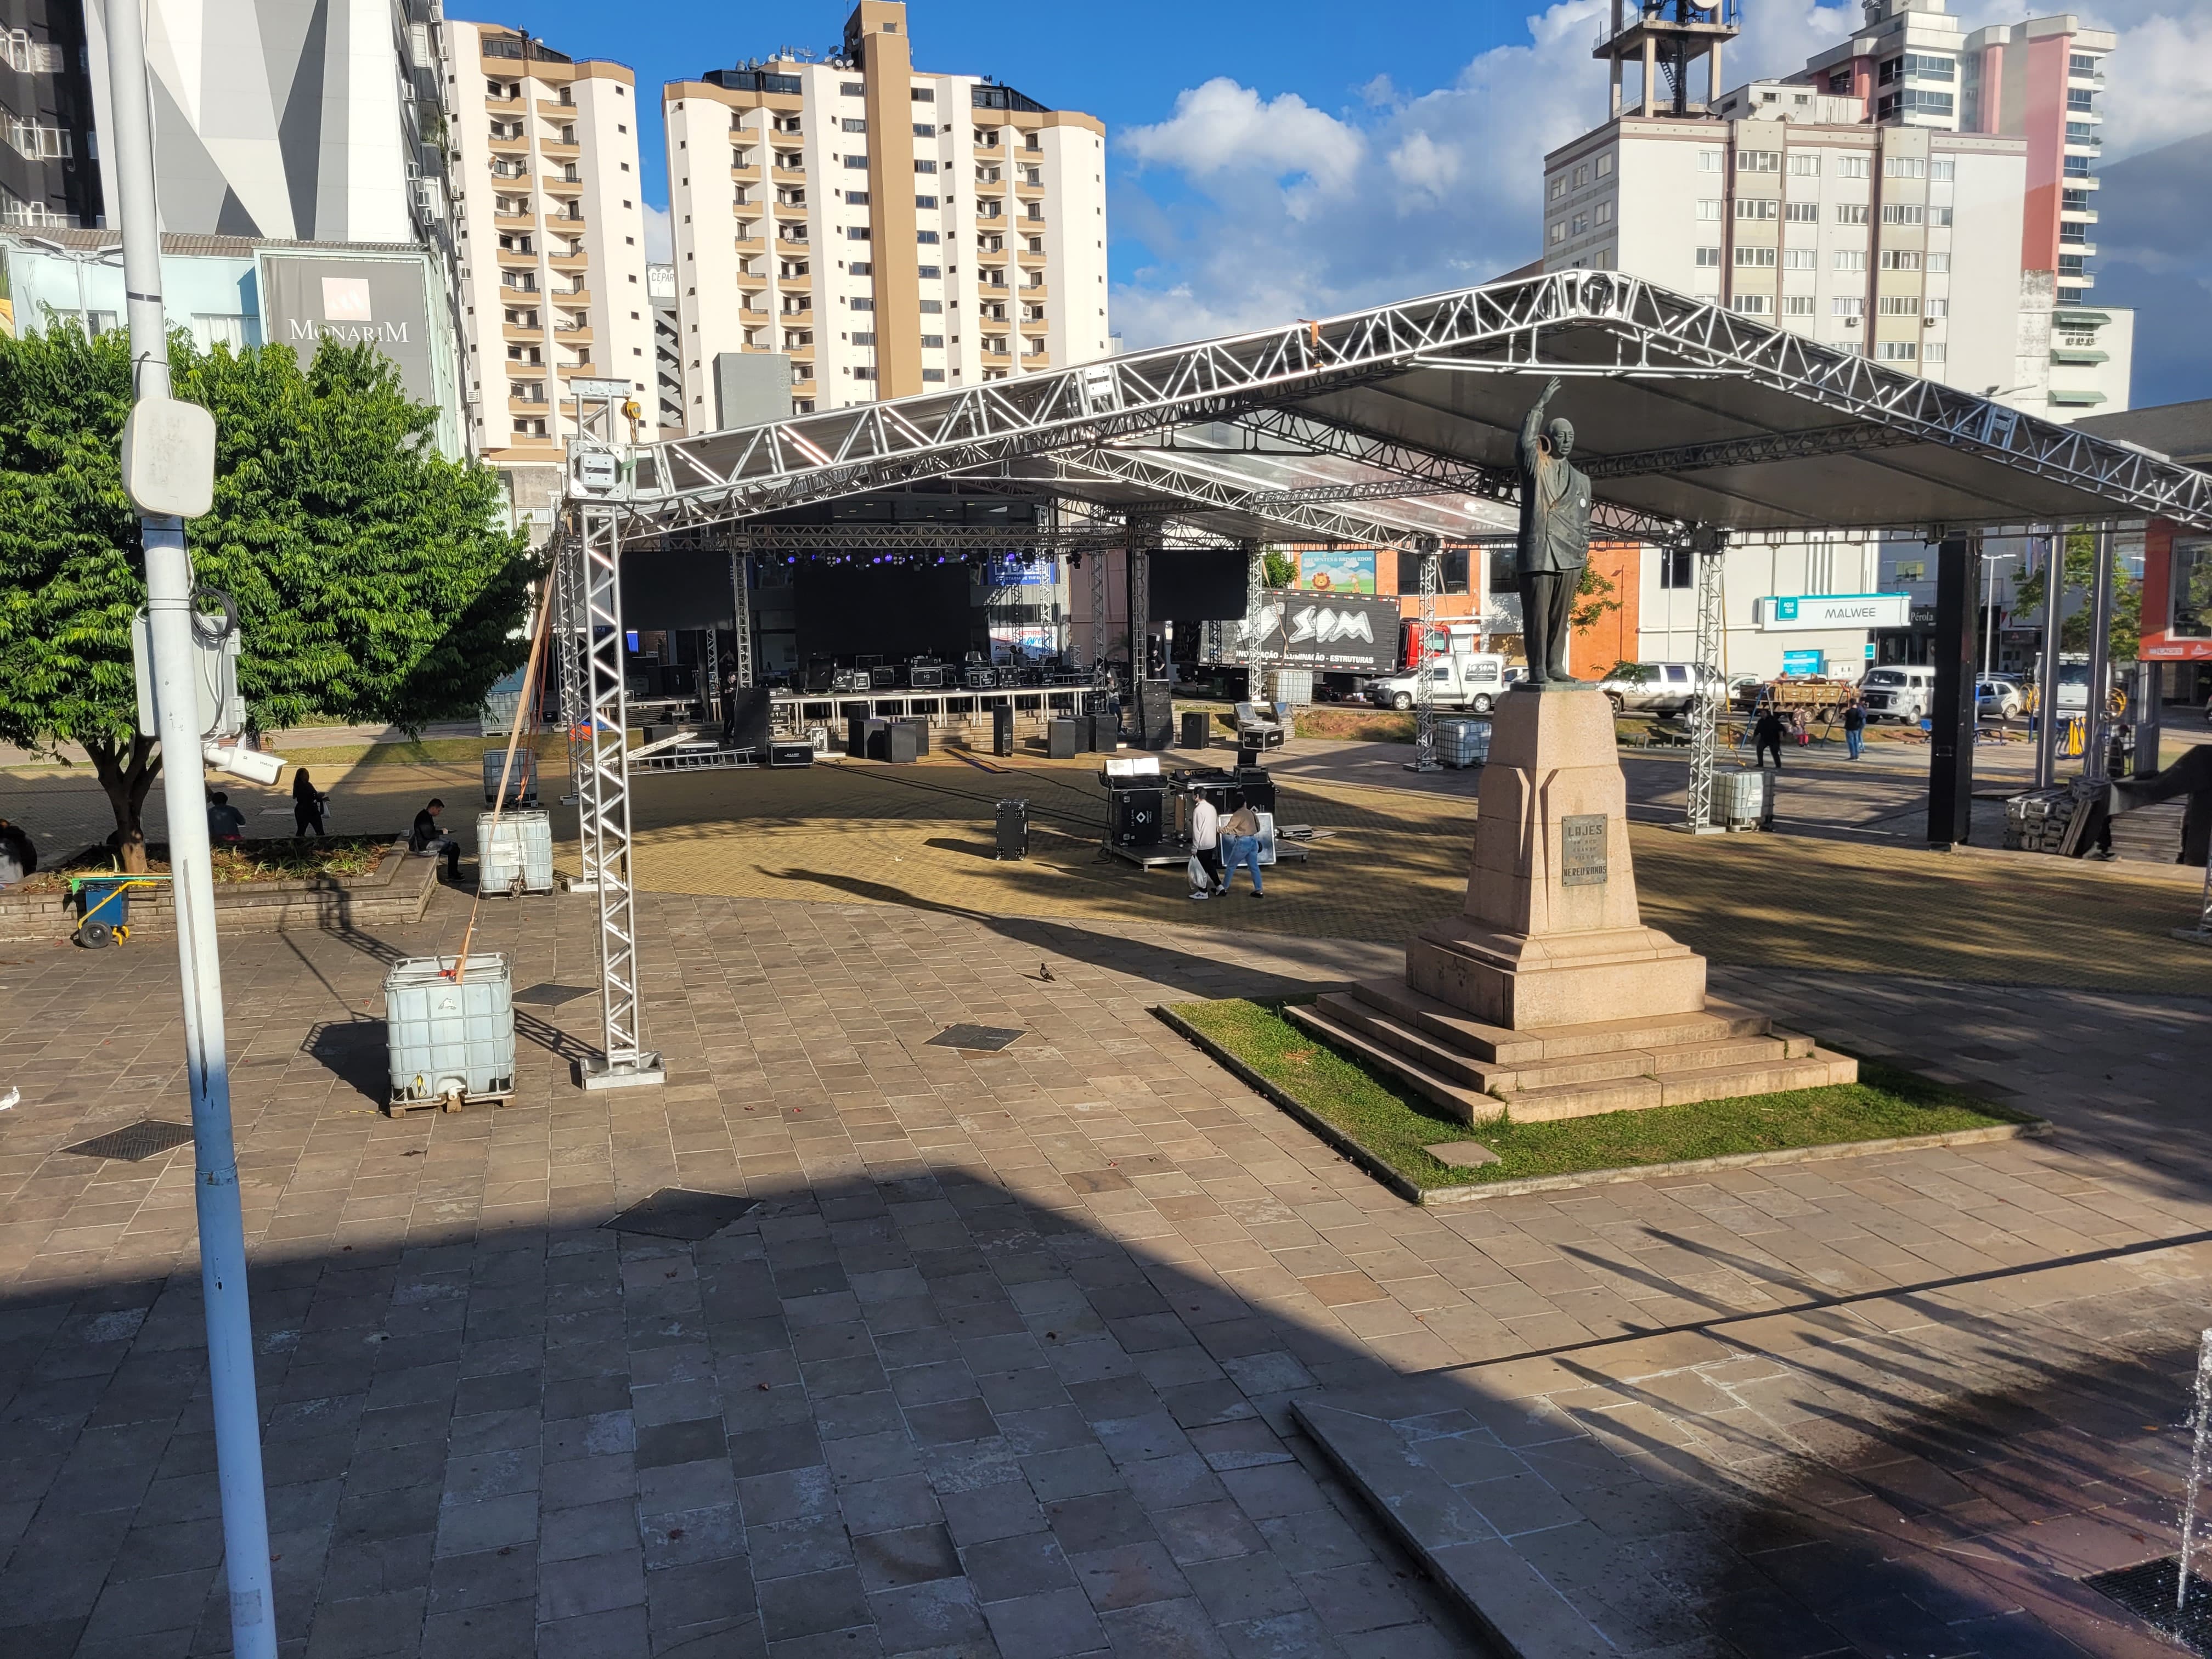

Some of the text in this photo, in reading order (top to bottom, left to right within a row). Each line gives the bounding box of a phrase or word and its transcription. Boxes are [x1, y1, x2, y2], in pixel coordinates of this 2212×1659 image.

[1825, 607, 1876, 619] MALWEE
[1910, 611, 1934, 622] Pérola
[1329, 654, 1374, 664] ESTRUTURAS
[1568, 825, 1602, 836] LAJES
